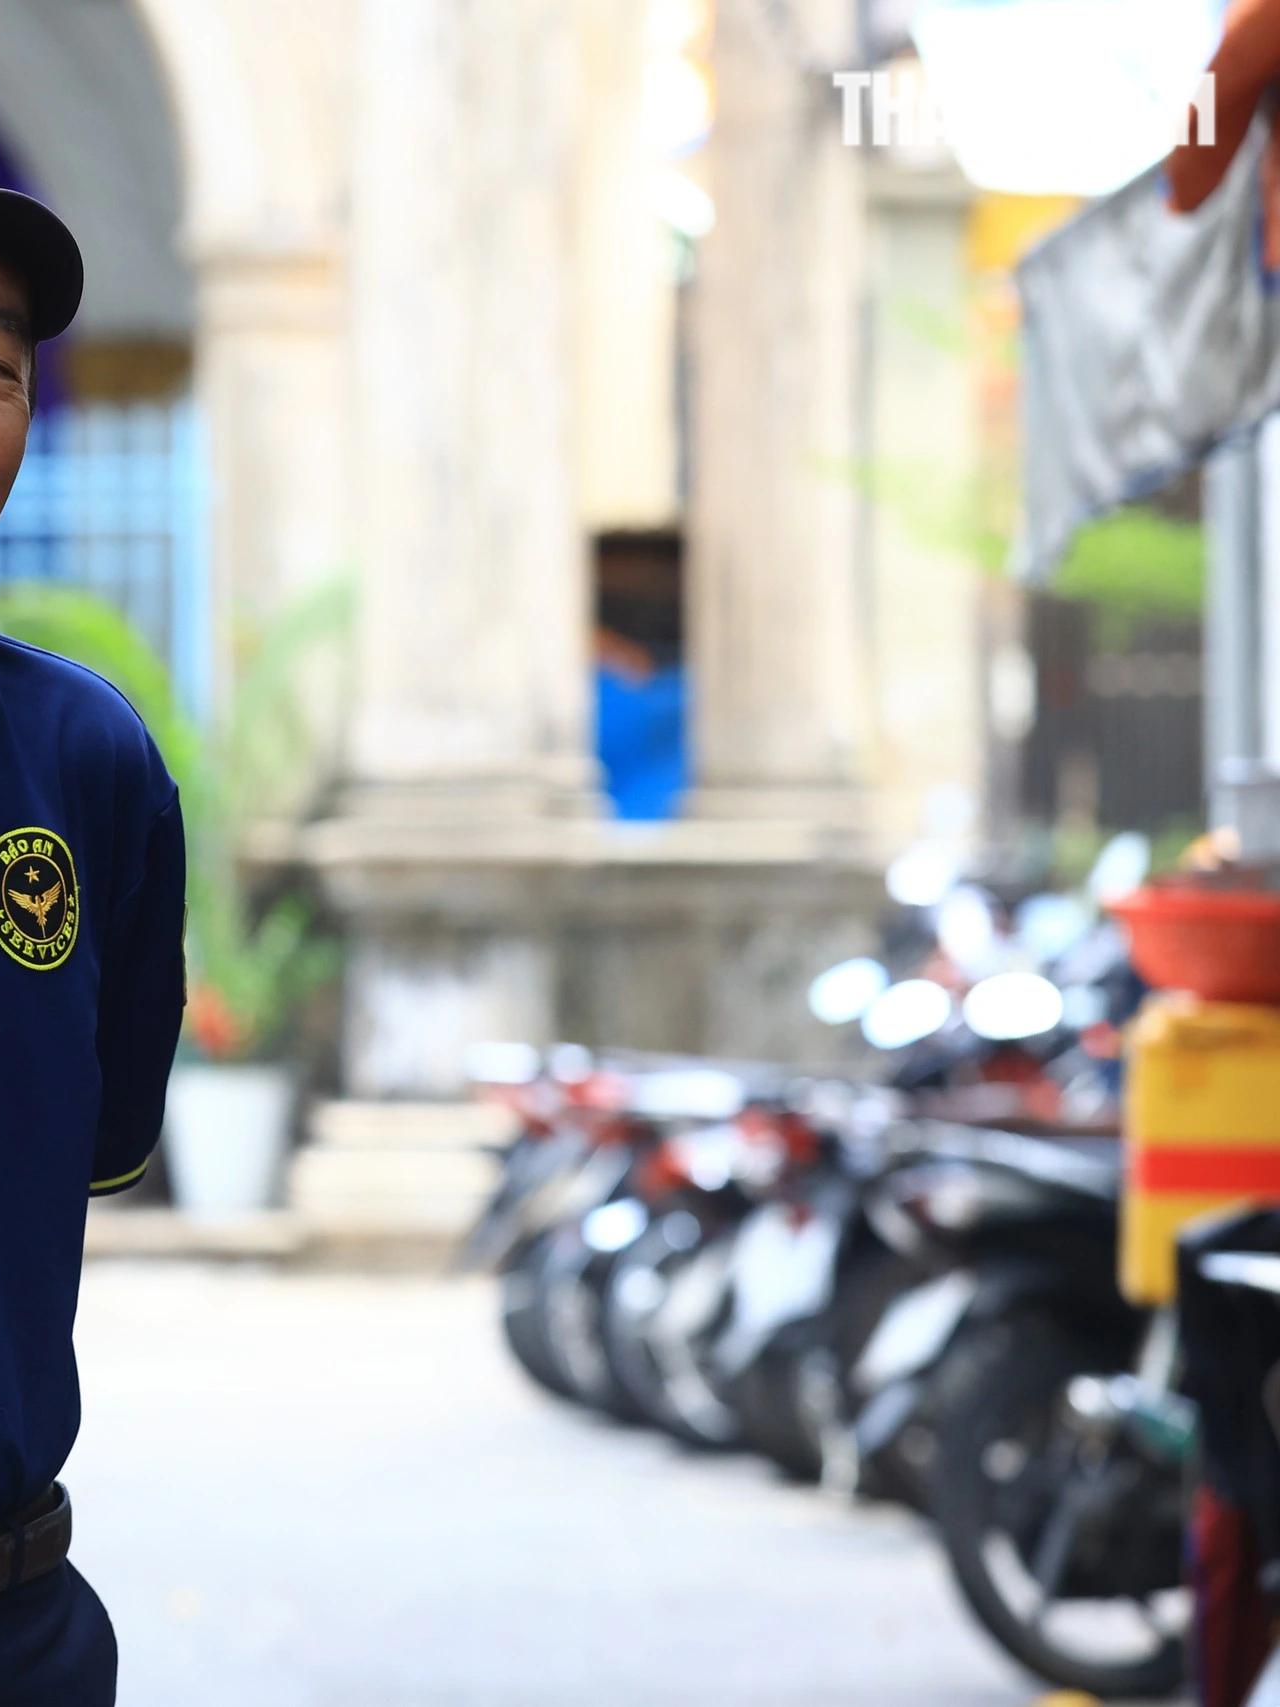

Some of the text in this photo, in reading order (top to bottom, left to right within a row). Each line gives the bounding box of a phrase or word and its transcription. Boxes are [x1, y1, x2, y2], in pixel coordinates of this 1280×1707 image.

[0, 838, 54, 865] BẢO AN
[0, 910, 75, 960] SERVICES
